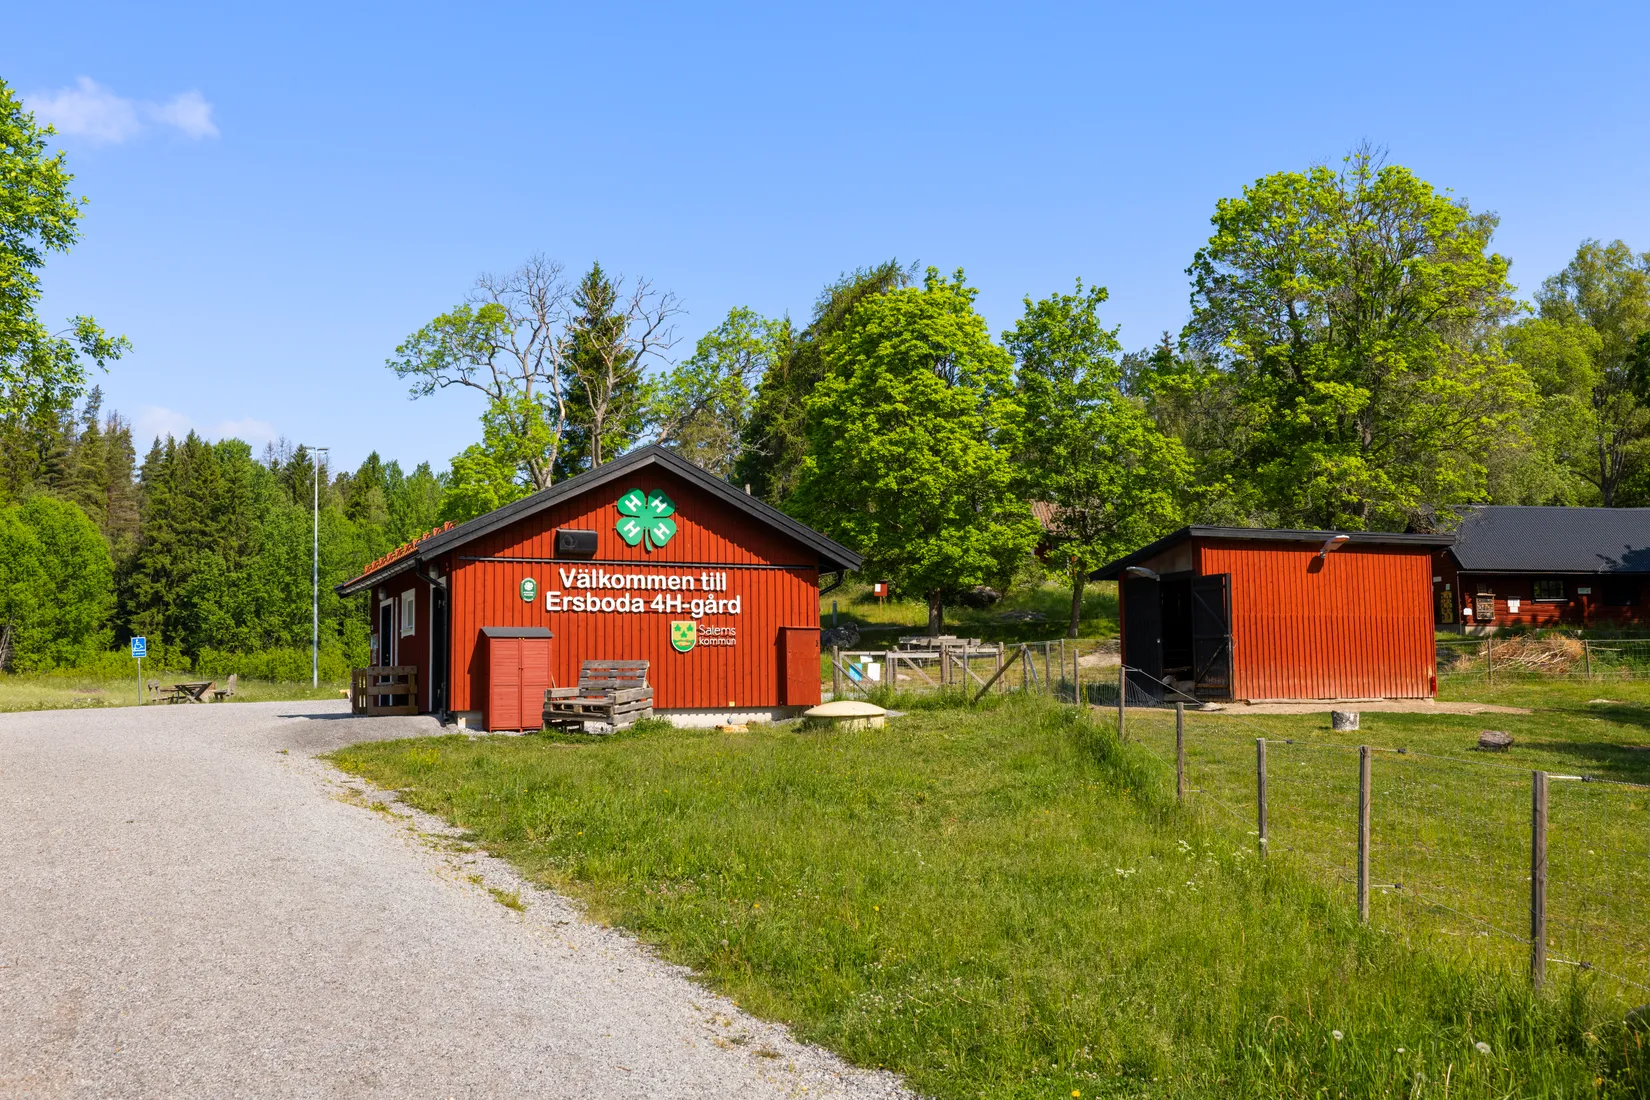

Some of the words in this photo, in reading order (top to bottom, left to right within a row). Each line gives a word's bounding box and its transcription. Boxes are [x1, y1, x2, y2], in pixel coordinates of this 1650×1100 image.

[625, 494, 642, 512] H
[651, 495, 667, 513] H
[623, 520, 640, 538] H
[653, 522, 670, 540] H
[559, 567, 694, 590] Välkommen
[701, 572, 726, 591] till
[546, 591, 644, 612] Ersboda
[650, 593, 740, 618] 4H-gård
[698, 624, 736, 636] Salems
[698, 636, 736, 645] kommun
